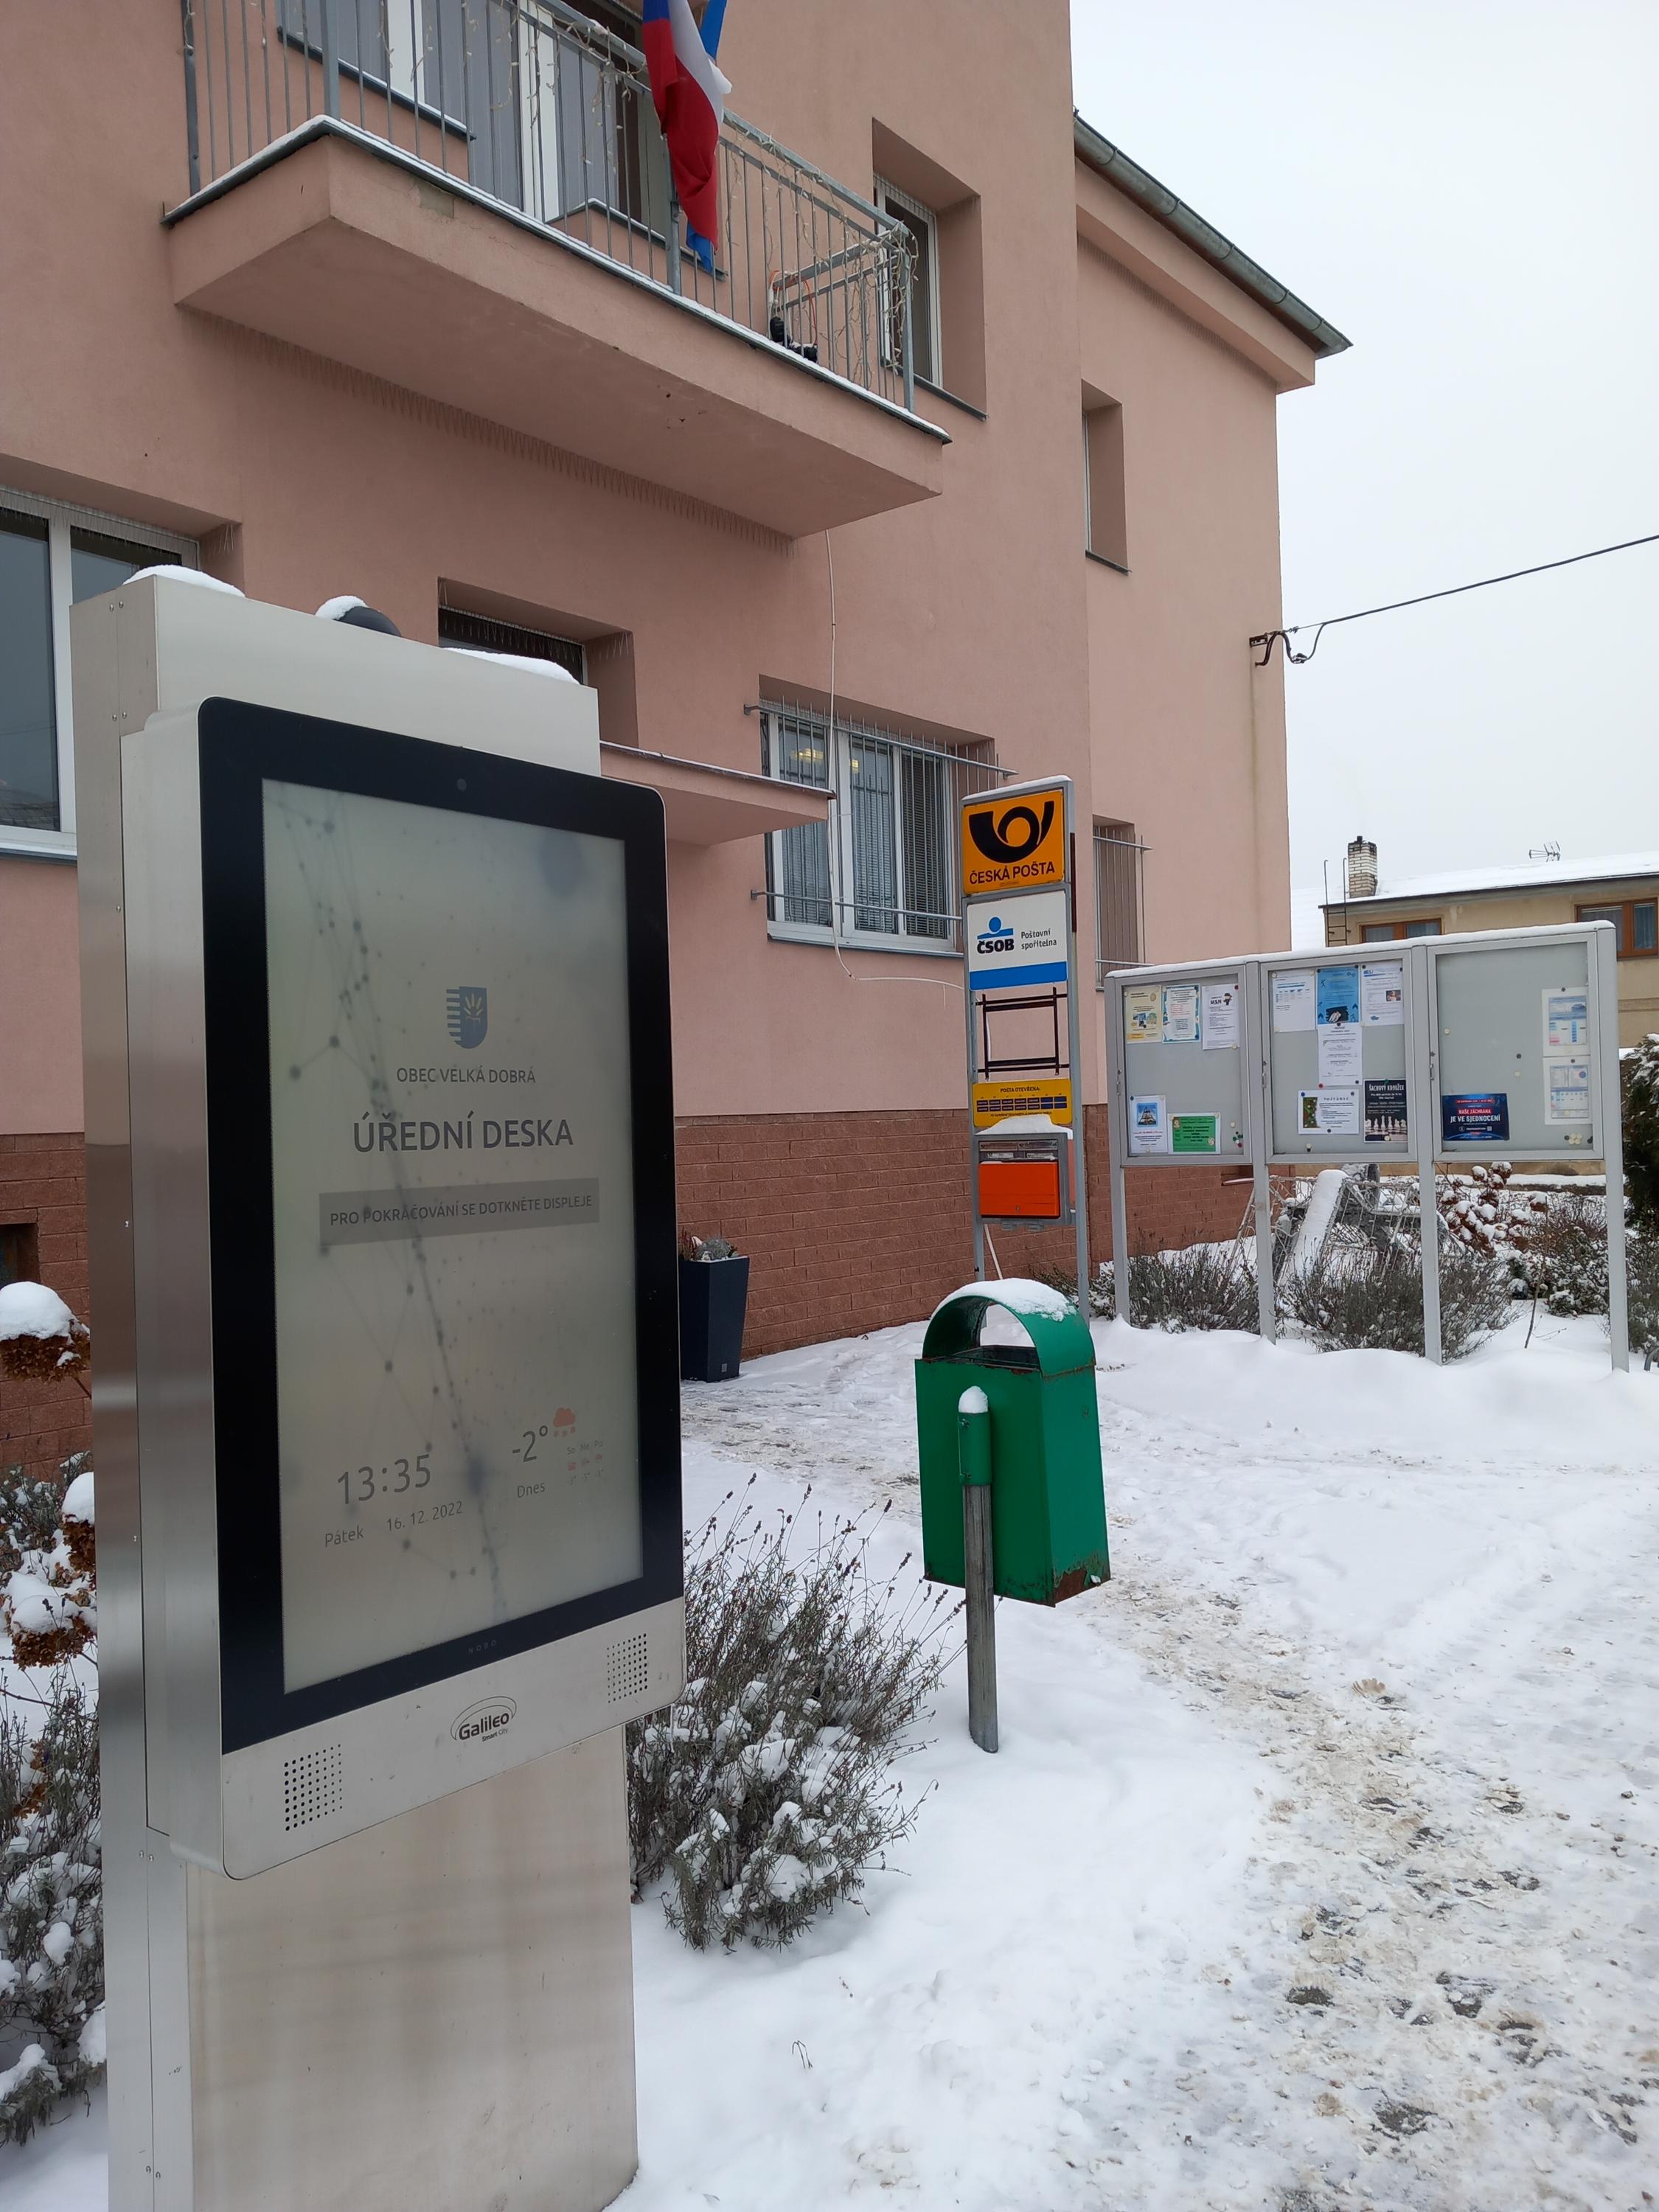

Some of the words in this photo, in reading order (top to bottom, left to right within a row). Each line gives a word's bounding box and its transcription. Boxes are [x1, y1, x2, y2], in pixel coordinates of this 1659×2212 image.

[970, 865, 1010, 884] ČESKÁ
[1012, 860, 1055, 879] POŠTA
[1020, 928, 1051, 939] Poštovní
[1020, 937, 1057, 950] spořitelna
[977, 938, 1015, 954] ČSOB
[396, 1067, 437, 1083] OBEC
[439, 1064, 486, 1083] VELKÁ
[488, 1065, 536, 1084] DOBRÁ
[353, 1110, 475, 1153] ÚŘEDNÍ
[483, 1119, 574, 1149] DESKA
[330, 1211, 360, 1226] PRO
[363, 1200, 459, 1224] POKRAČOVÁNÍ
[461, 1202, 476, 1216] SE
[479, 1197, 541, 1216] DOTKNĚTE
[543, 1194, 593, 1210] DISPLEJE
[336, 1453, 431, 1506] 13:35
[517, 1481, 546, 1499] Dnes
[324, 1525, 364, 1548] Pátek
[386, 1515, 406, 1532] 16.
[410, 1510, 429, 1527] 12.
[432, 1500, 464, 1522] 2022
[459, 1712, 509, 1741] Galileo
[481, 1731, 498, 1742] Smart
